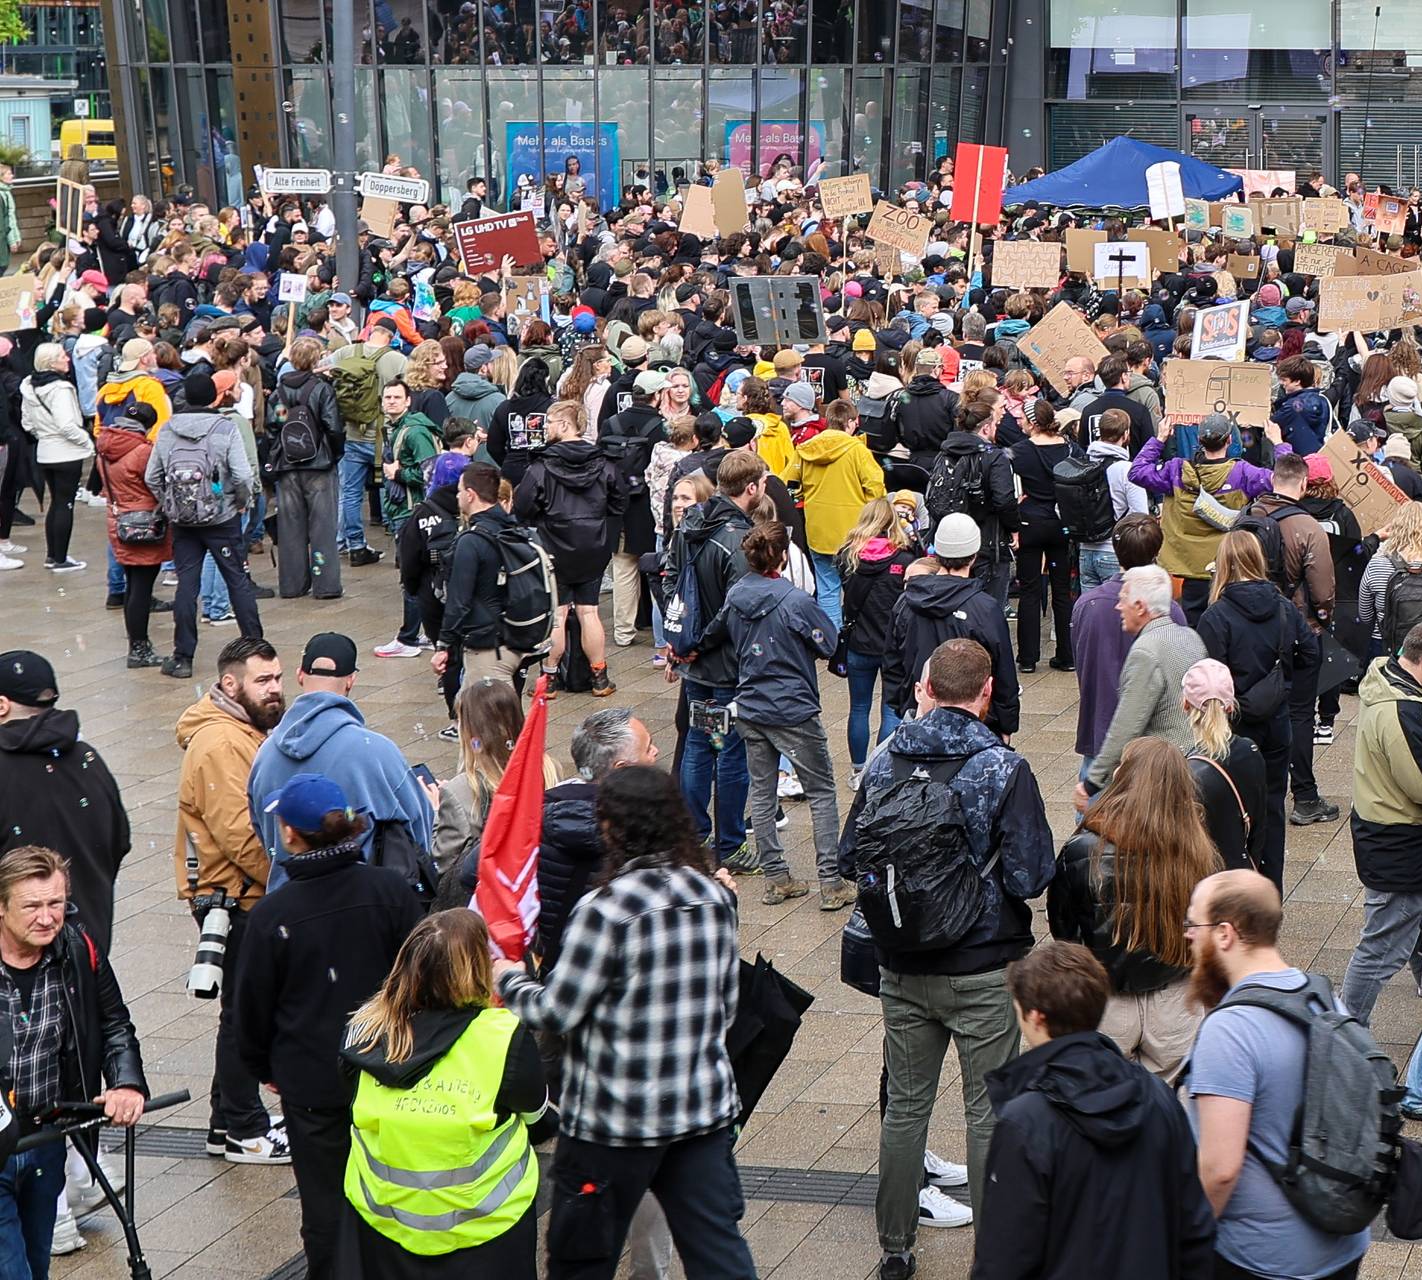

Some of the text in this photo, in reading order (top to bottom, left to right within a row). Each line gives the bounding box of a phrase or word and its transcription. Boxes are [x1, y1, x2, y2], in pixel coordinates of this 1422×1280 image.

[551, 135, 567, 146] als
[570, 135, 607, 146] Basis
[766, 133, 780, 143] als
[274, 175, 321, 187] Alte Freiheit
[369, 179, 419, 199] Döppersberg
[460, 225, 475, 237] LG
[475, 222, 494, 234] UHD
[493, 219, 507, 230] TV
[1361, 254, 1410, 273] A CAGE
